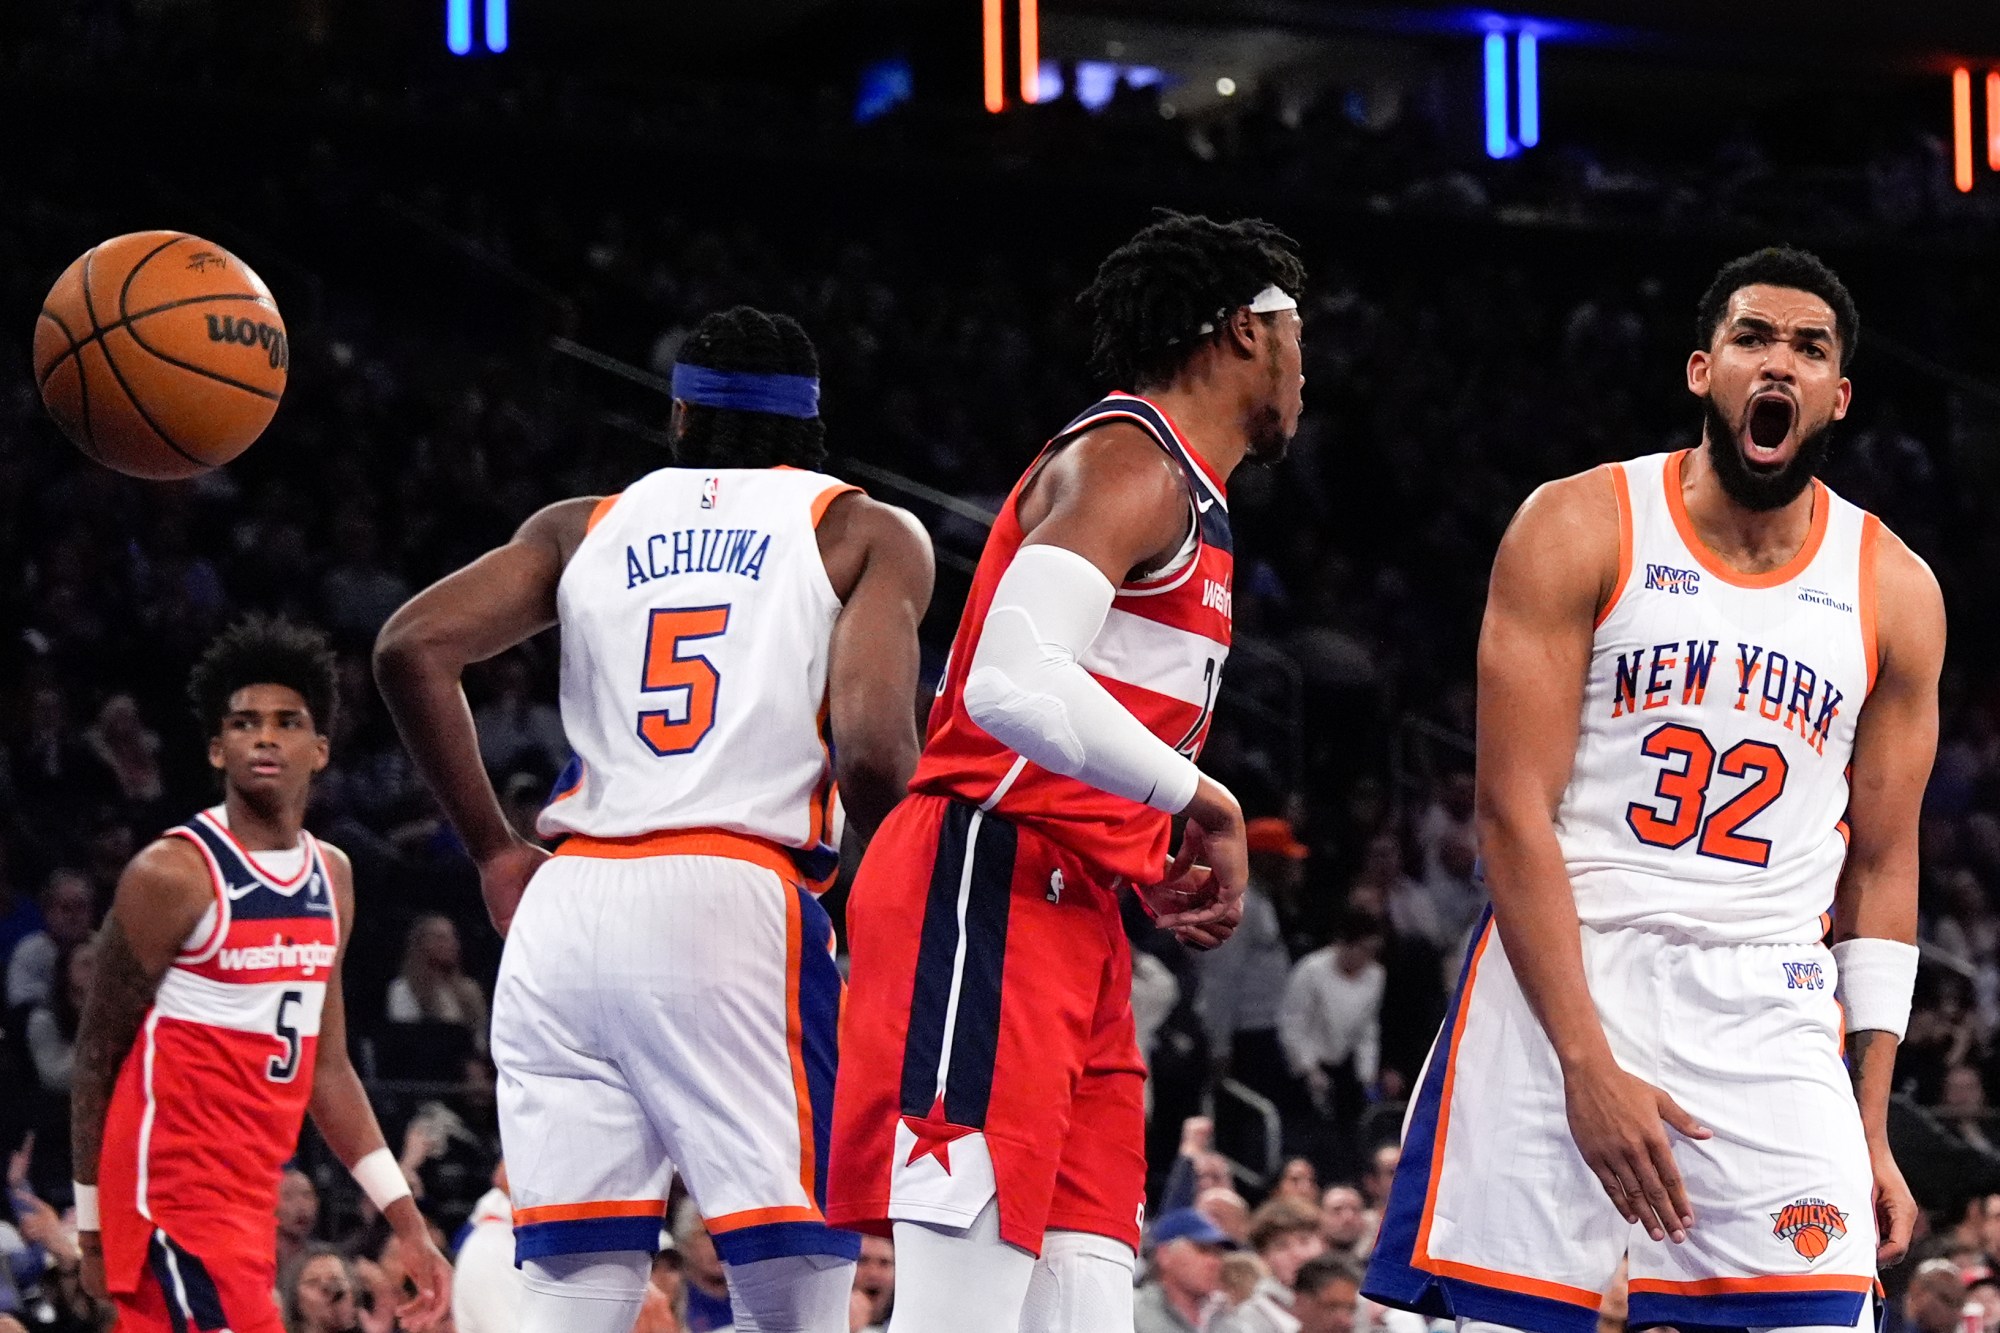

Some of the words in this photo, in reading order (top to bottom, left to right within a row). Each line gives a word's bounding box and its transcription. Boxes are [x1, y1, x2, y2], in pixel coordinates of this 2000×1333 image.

[627, 529, 771, 590] ACHIUWA
[1645, 563, 1700, 595] NYC
[1797, 593, 1820, 604] abu
[1821, 597, 1853, 614] dhabi
[637, 603, 731, 757] 5
[1611, 640, 1719, 718] NEW
[1734, 642, 1843, 757] YORK
[1626, 722, 1789, 868] 32
[1783, 962, 1825, 990] NYC
[266, 989, 302, 1083] 5
[1774, 1203, 1848, 1233] KNICKS
